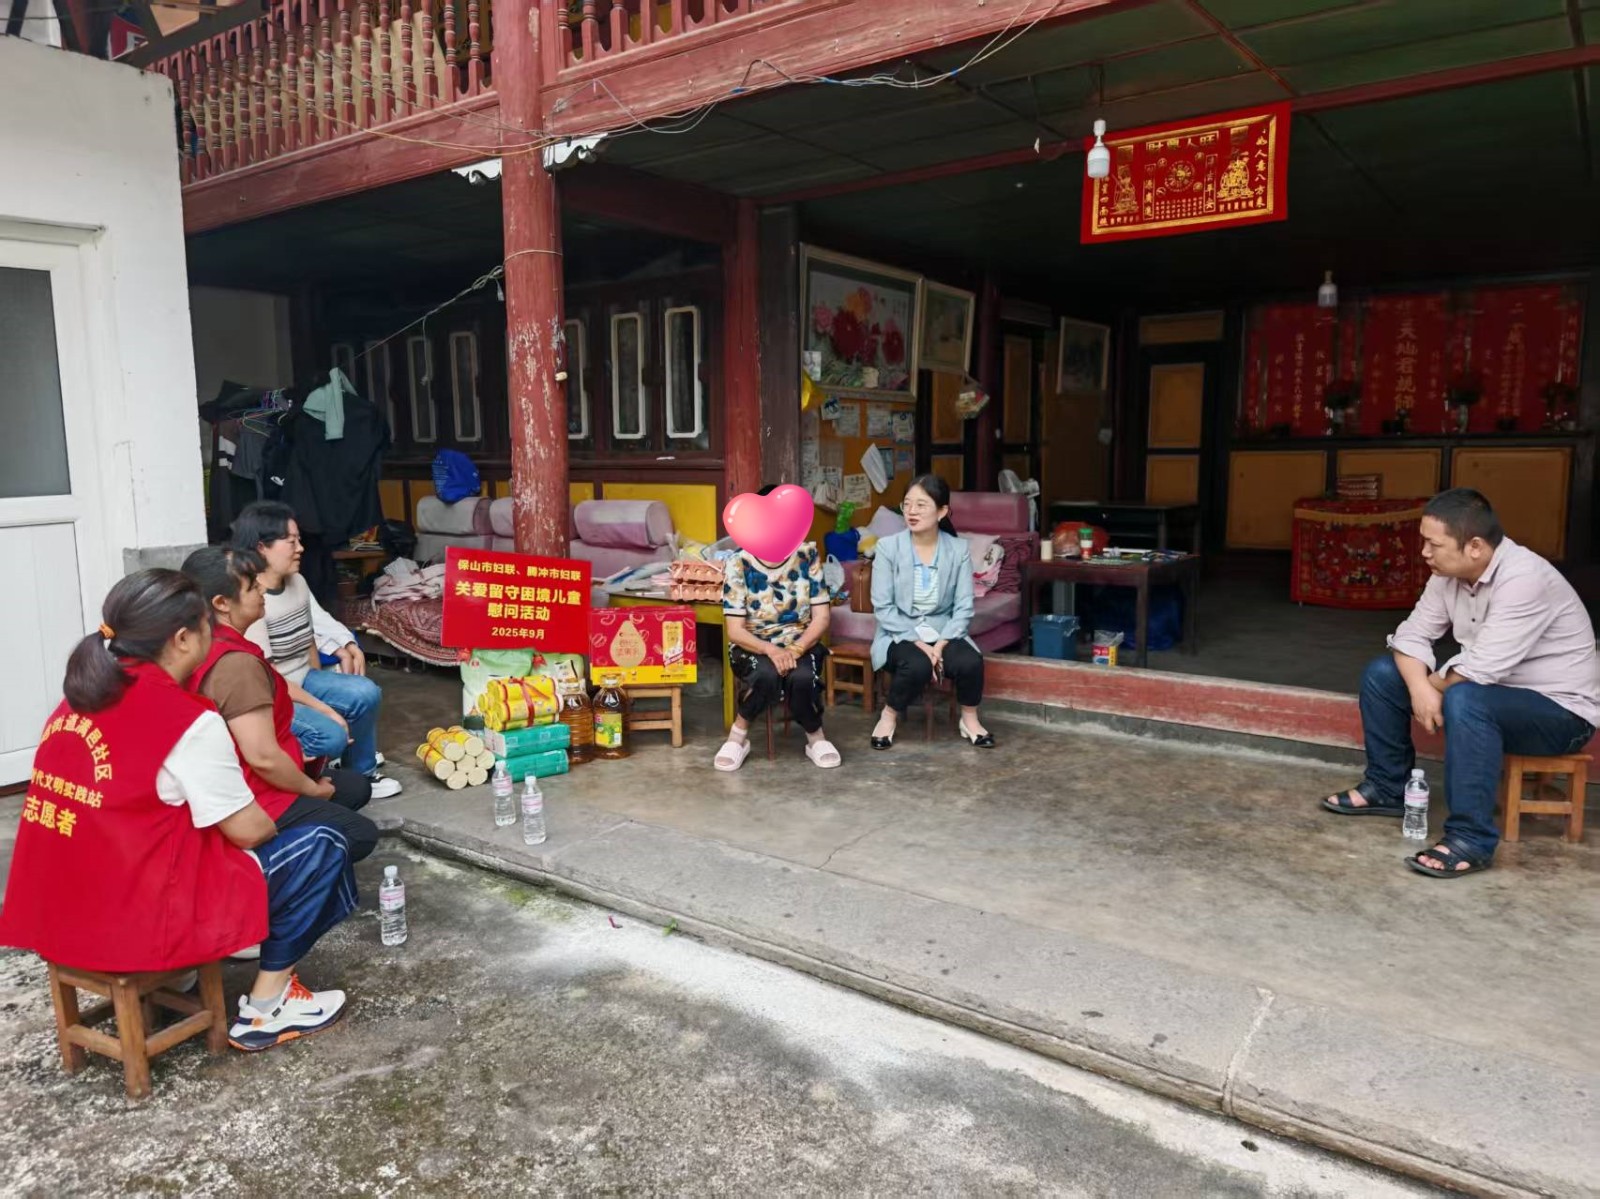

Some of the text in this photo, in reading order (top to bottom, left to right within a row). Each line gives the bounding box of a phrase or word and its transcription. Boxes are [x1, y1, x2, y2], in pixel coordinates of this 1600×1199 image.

[457, 559, 581, 581] 保山市妇联、腾冲市妇联
[455, 580, 582, 605] 关爱留守困境儿童
[487, 602, 551, 621] 慰问活动
[491, 626, 545, 640] 2025年9月
[23, 794, 77, 837] 志愿者
